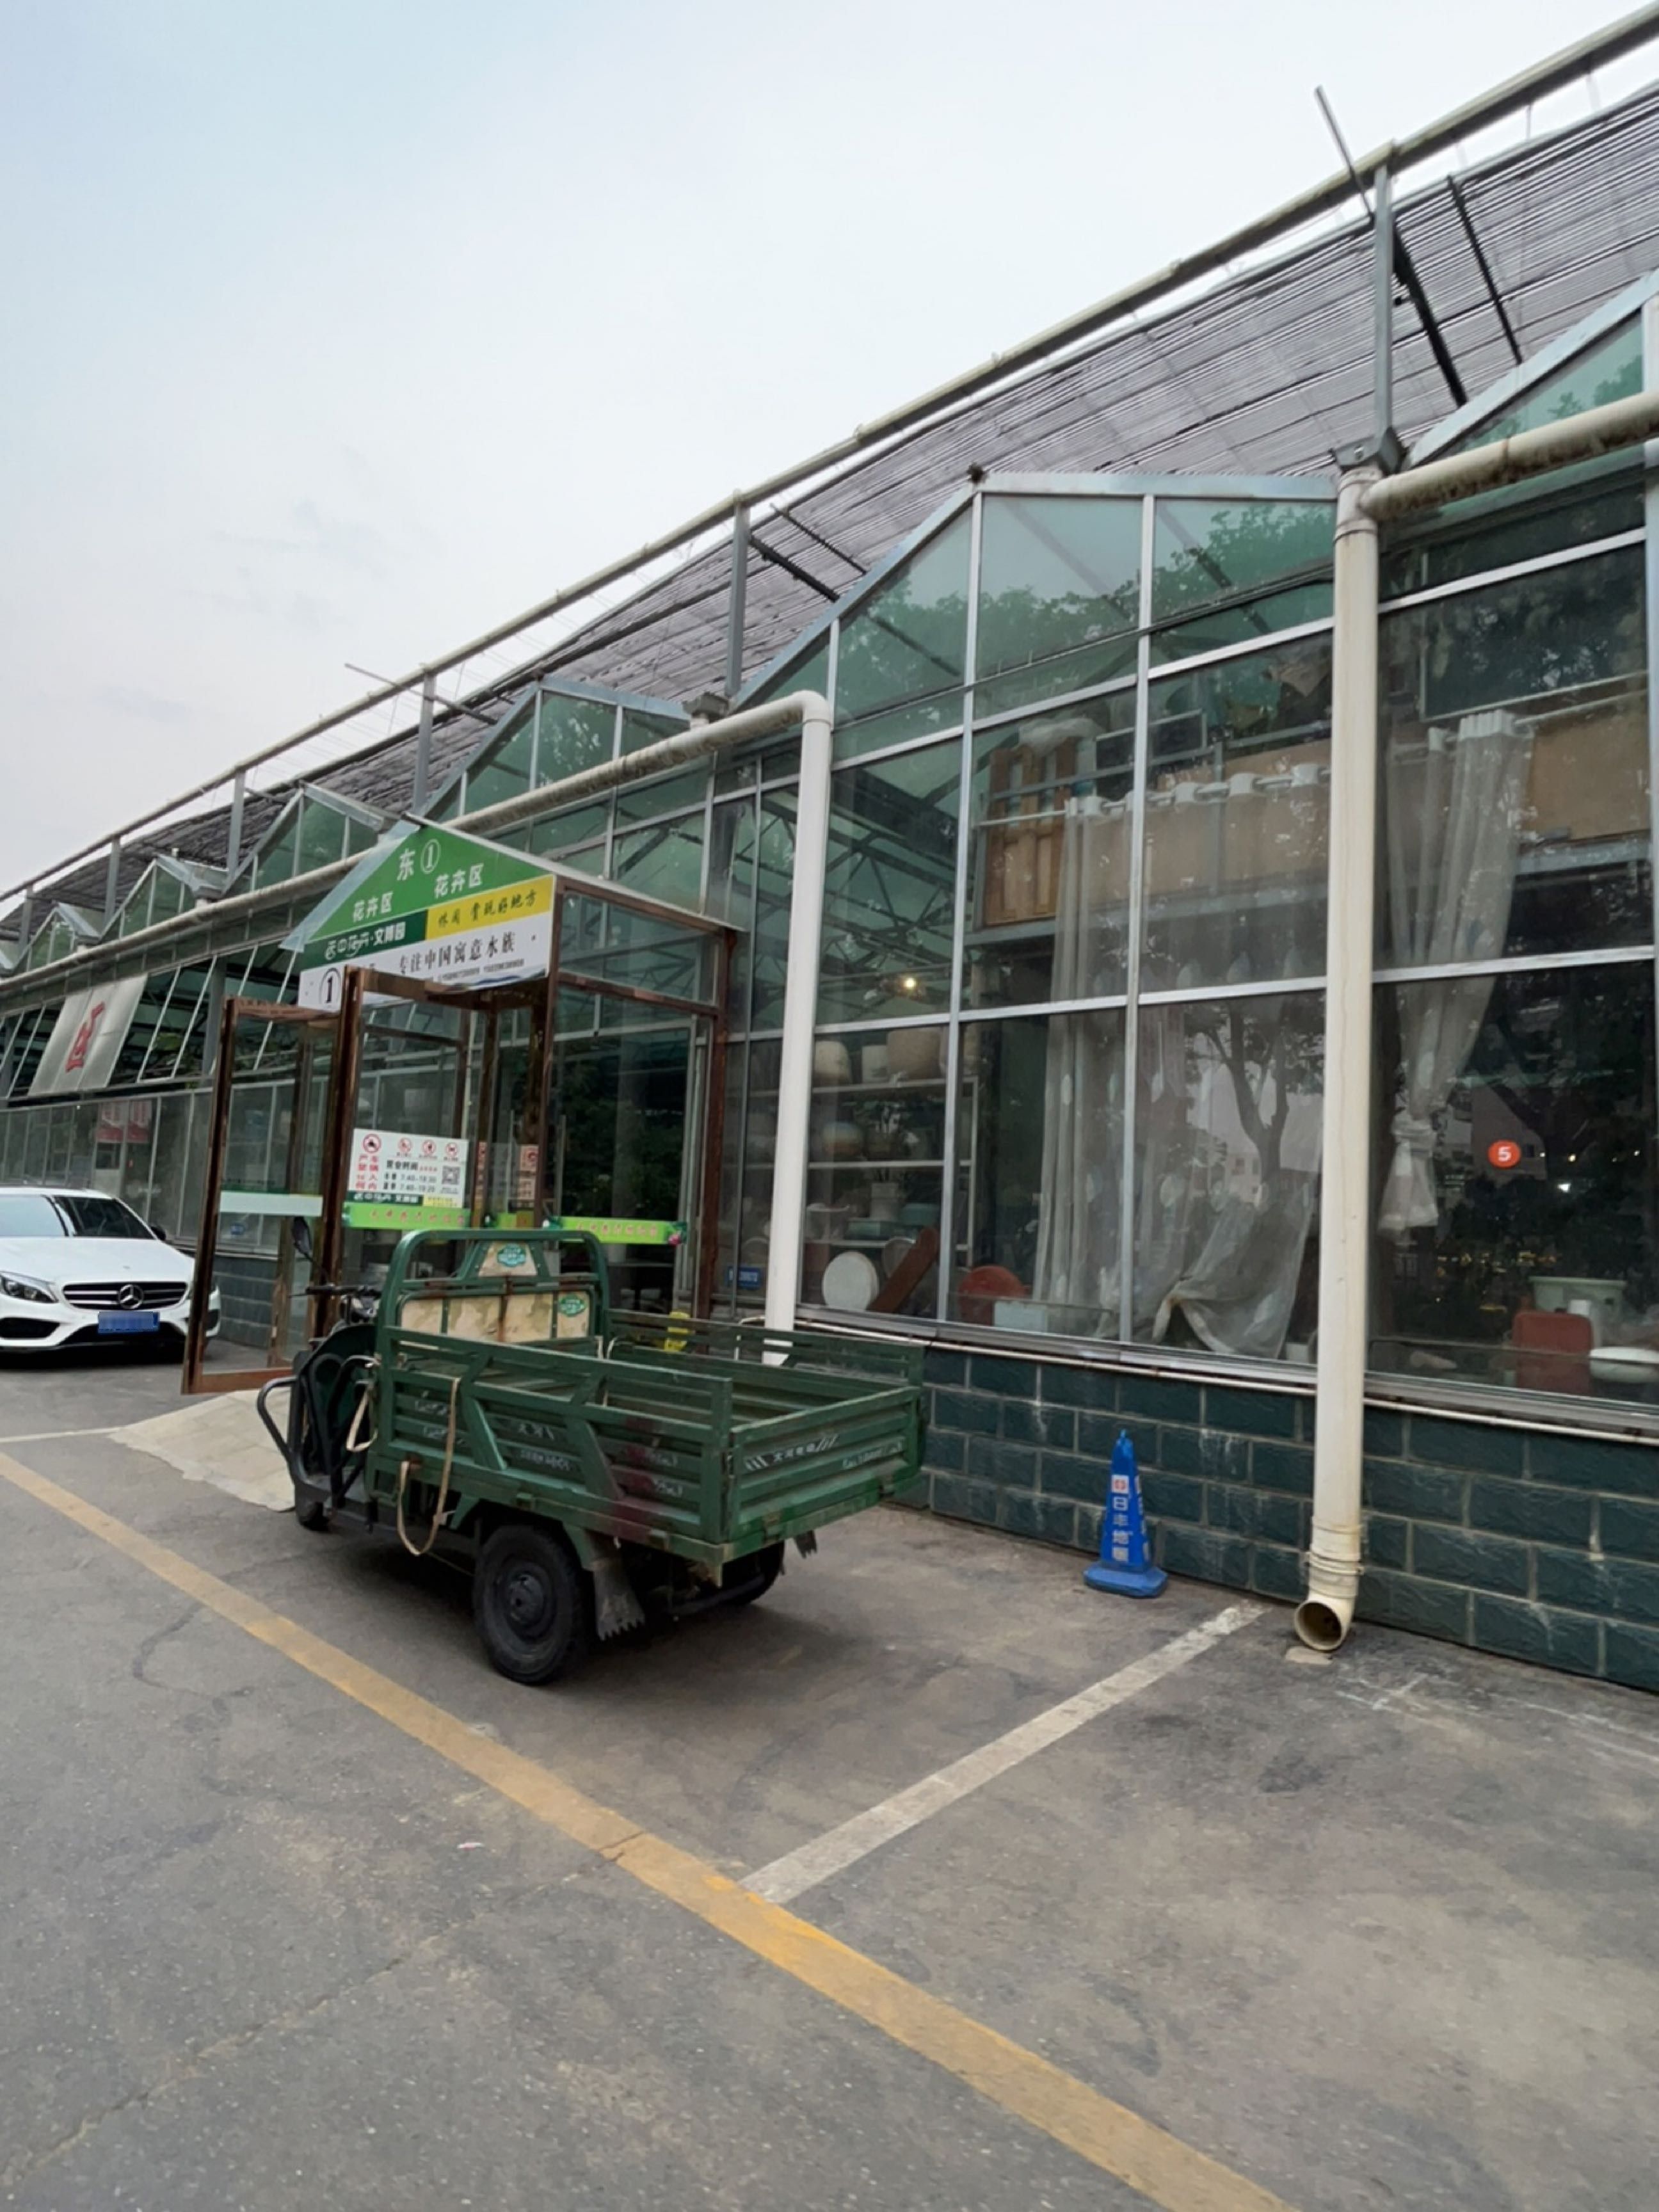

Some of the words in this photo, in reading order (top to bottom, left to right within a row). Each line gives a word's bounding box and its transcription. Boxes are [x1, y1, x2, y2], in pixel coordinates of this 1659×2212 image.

[434, 863, 484, 899] 花卉区
[353, 892, 393, 923] 花卉区
[1498, 1146, 1512, 1162] 5
